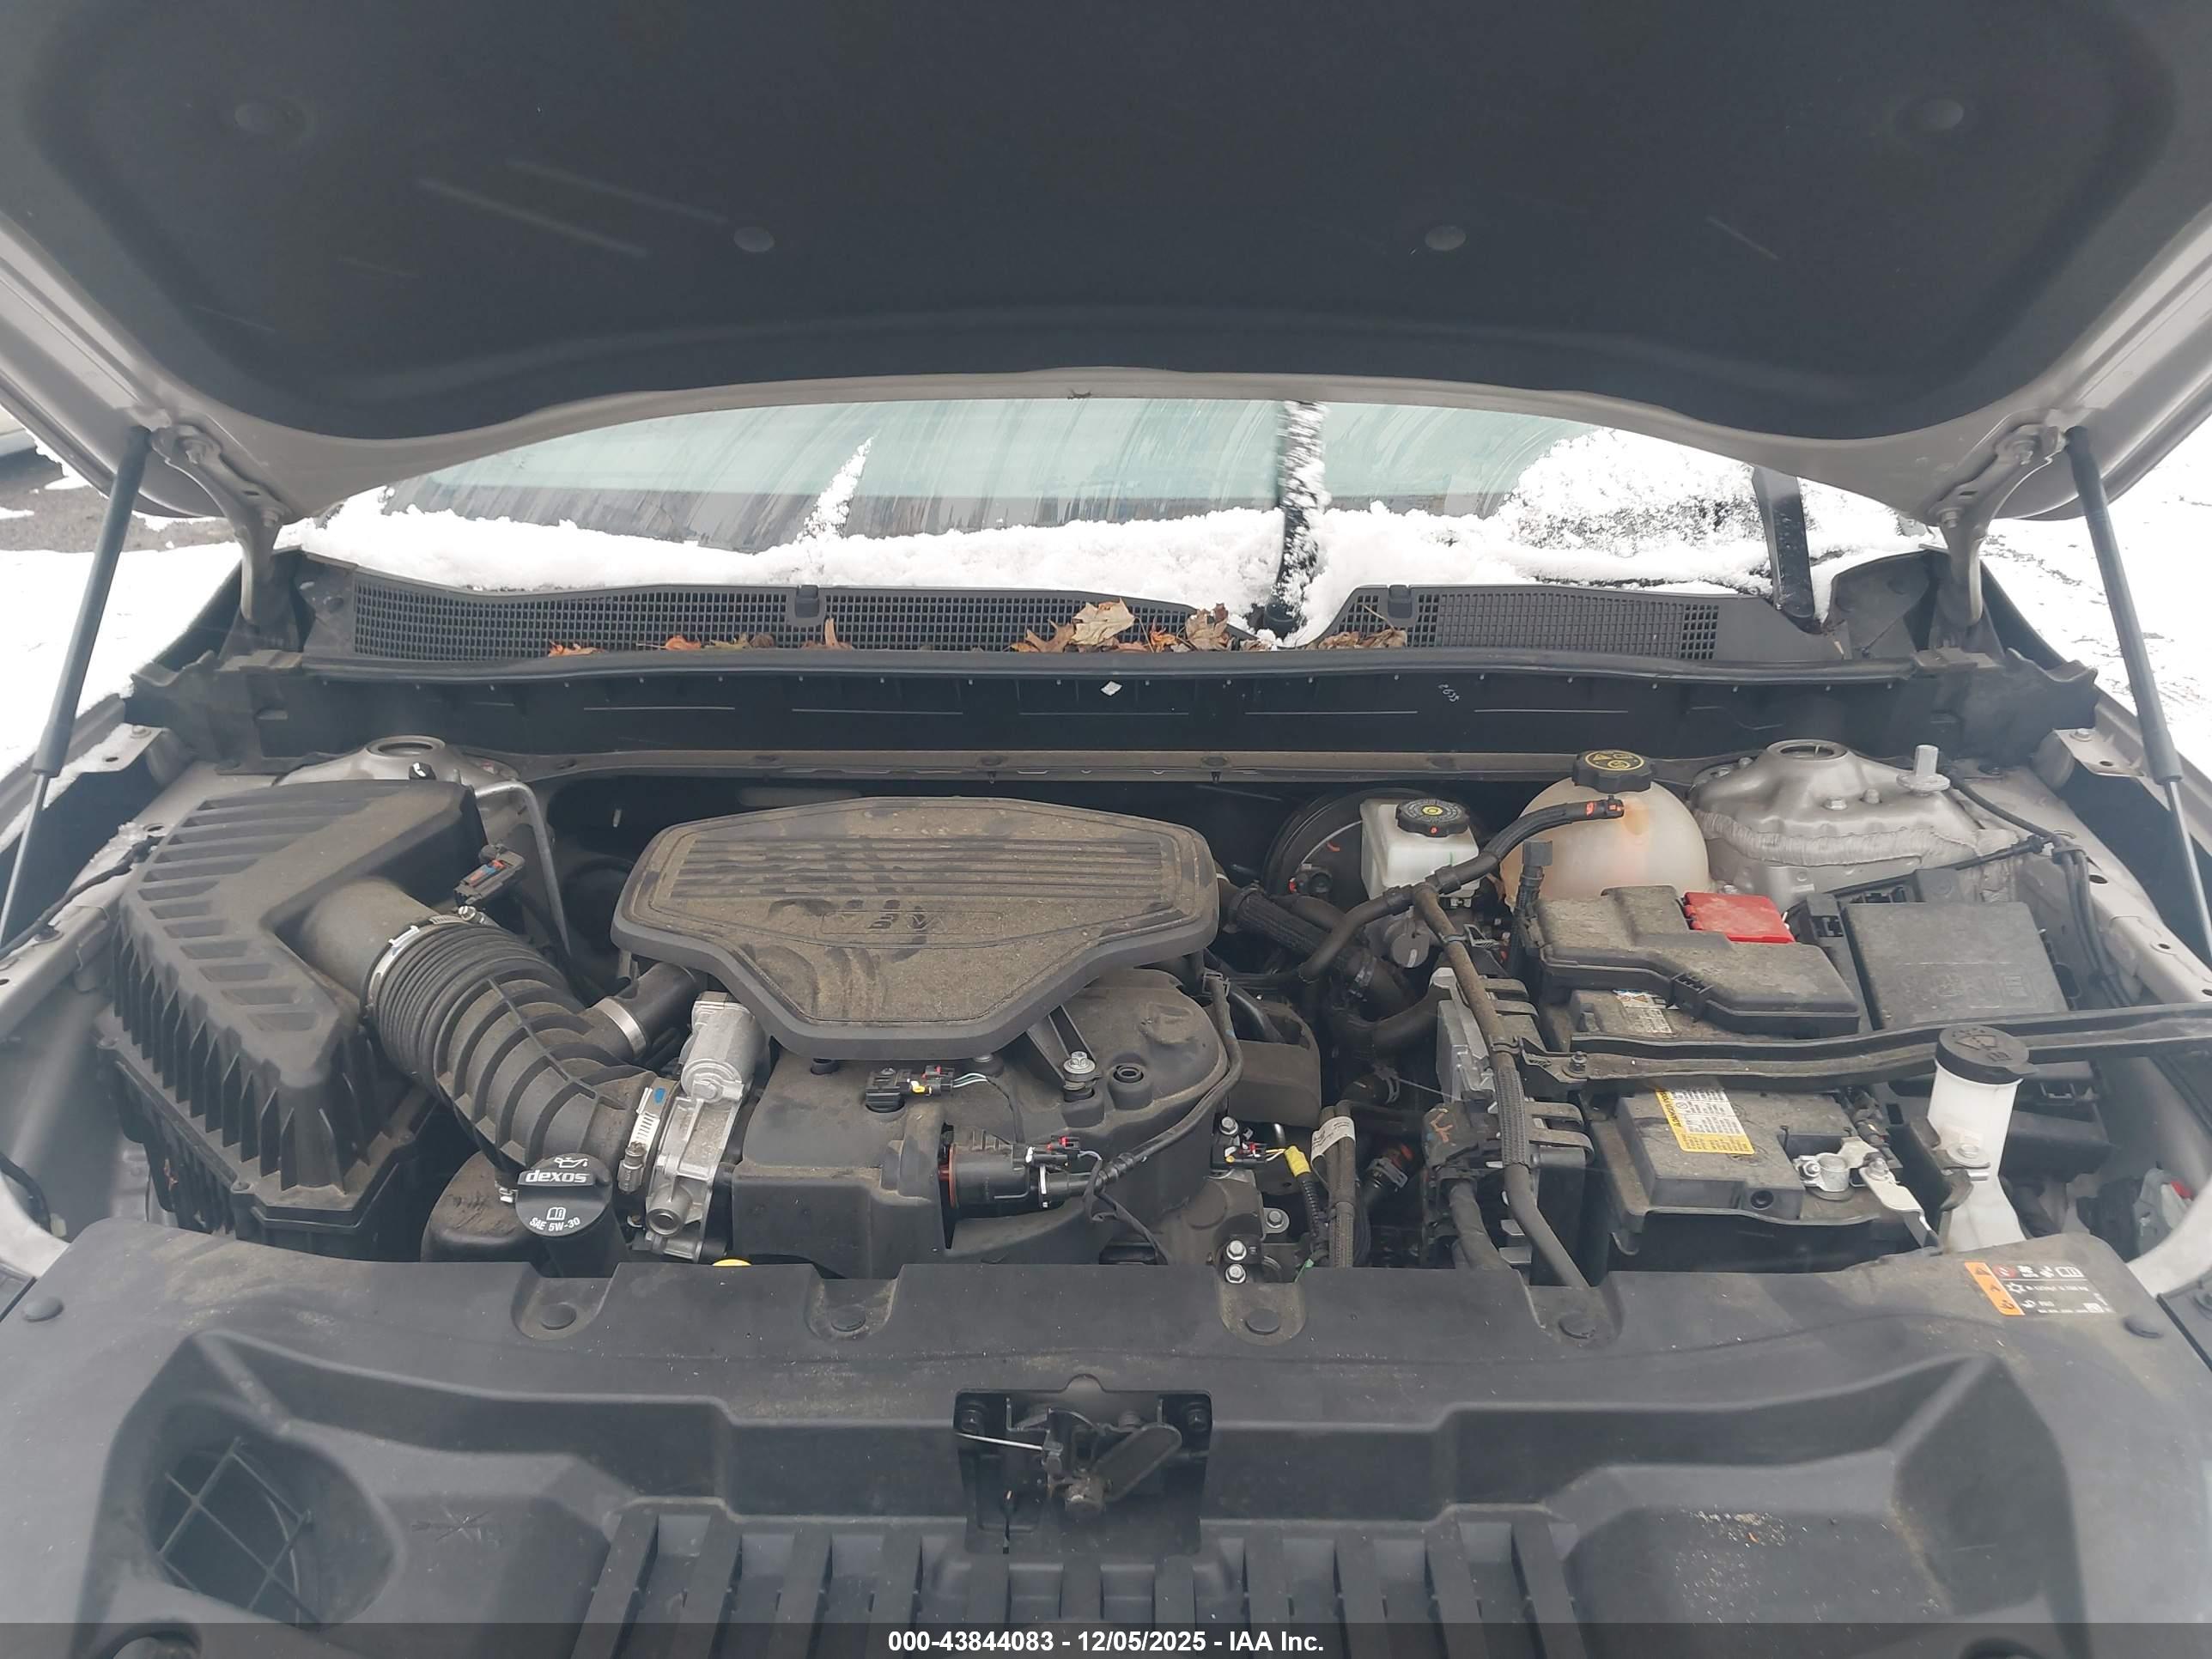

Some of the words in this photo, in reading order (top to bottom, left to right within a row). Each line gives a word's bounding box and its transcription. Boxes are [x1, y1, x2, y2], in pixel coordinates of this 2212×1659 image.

[526, 1170, 590, 1182] dexos
[529, 1217, 547, 1231] SAE
[548, 1217, 580, 1231] 5W-30
